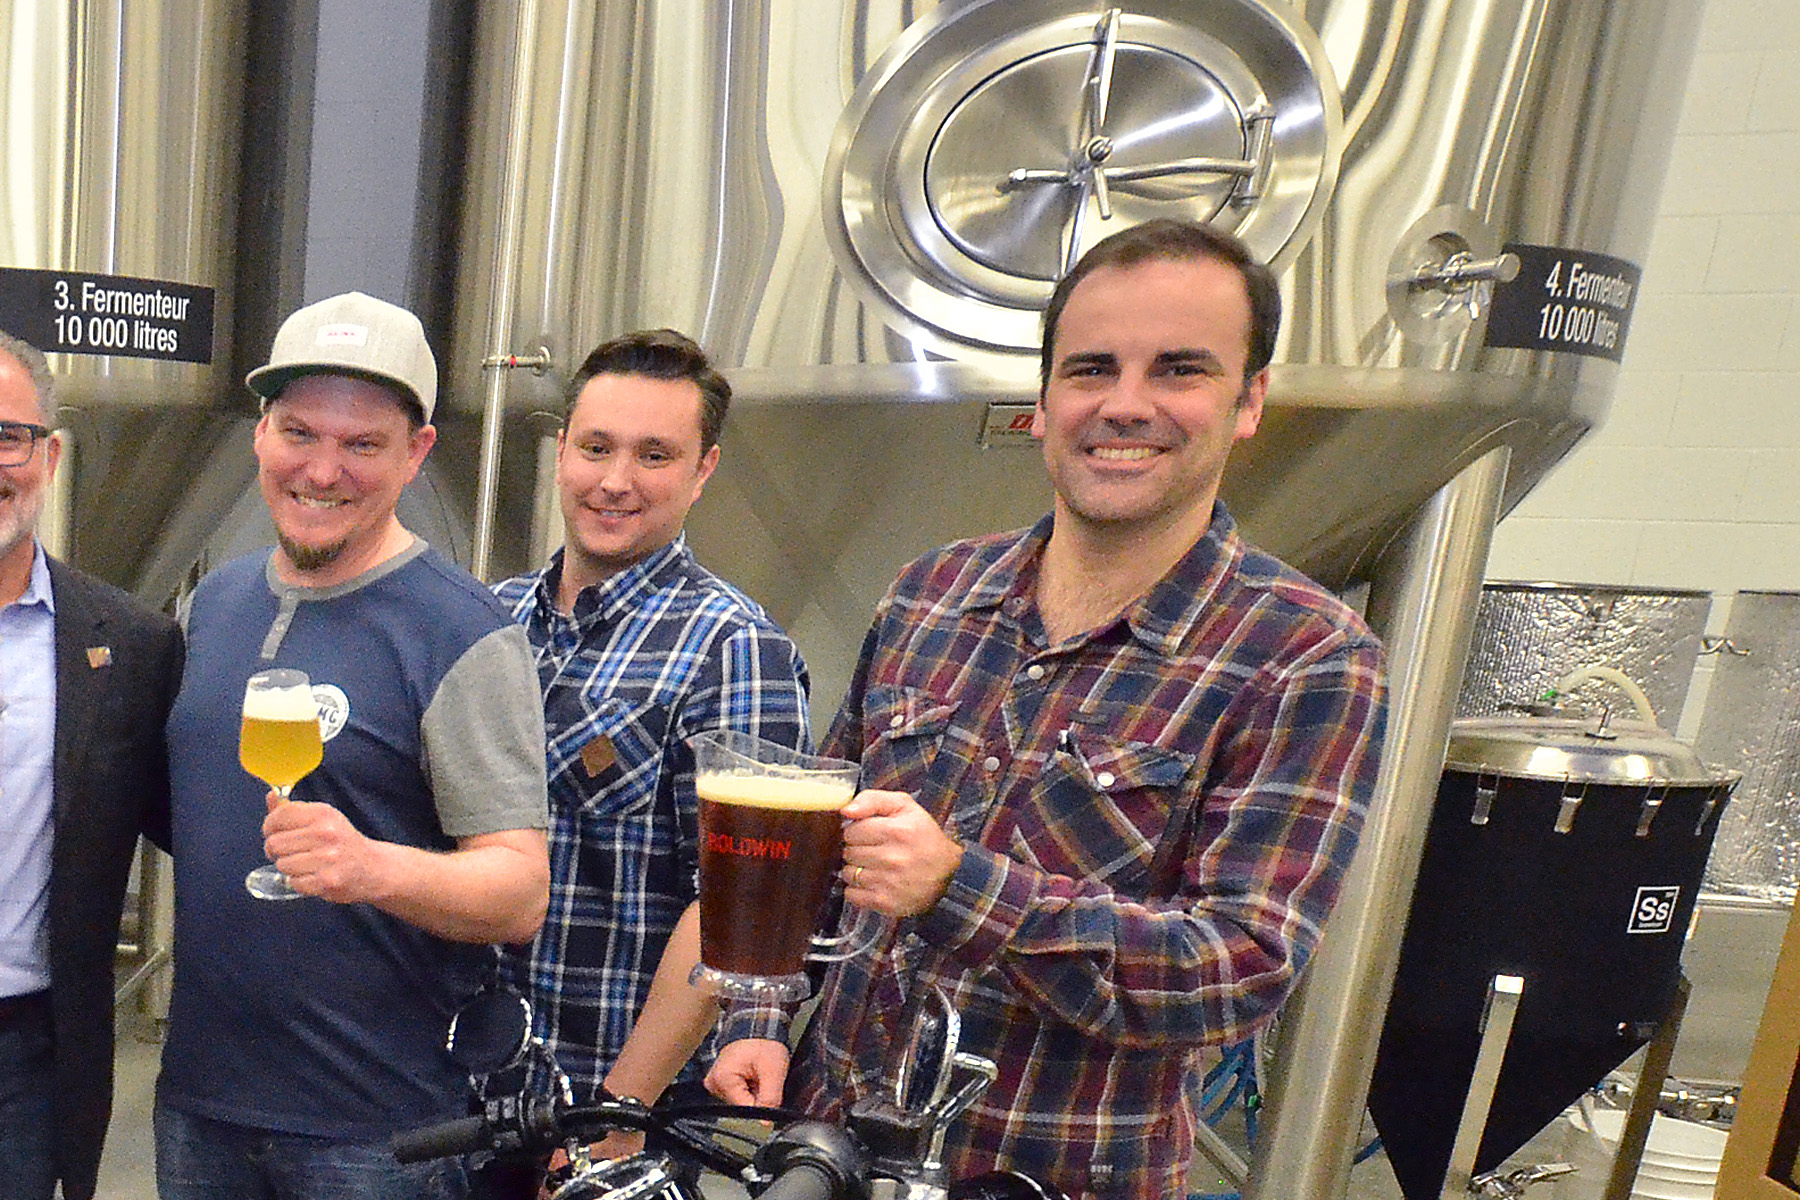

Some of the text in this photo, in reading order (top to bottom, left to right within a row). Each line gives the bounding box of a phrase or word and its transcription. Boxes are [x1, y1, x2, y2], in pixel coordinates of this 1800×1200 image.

[1545, 260, 1563, 297] 4.
[54, 281, 190, 321] 3. Fermenteur
[55, 315, 178, 353] 10 000 litres
[1539, 303, 1564, 340] 10
[1564, 306, 1595, 343] 000
[1638, 897, 1670, 921] Ss
